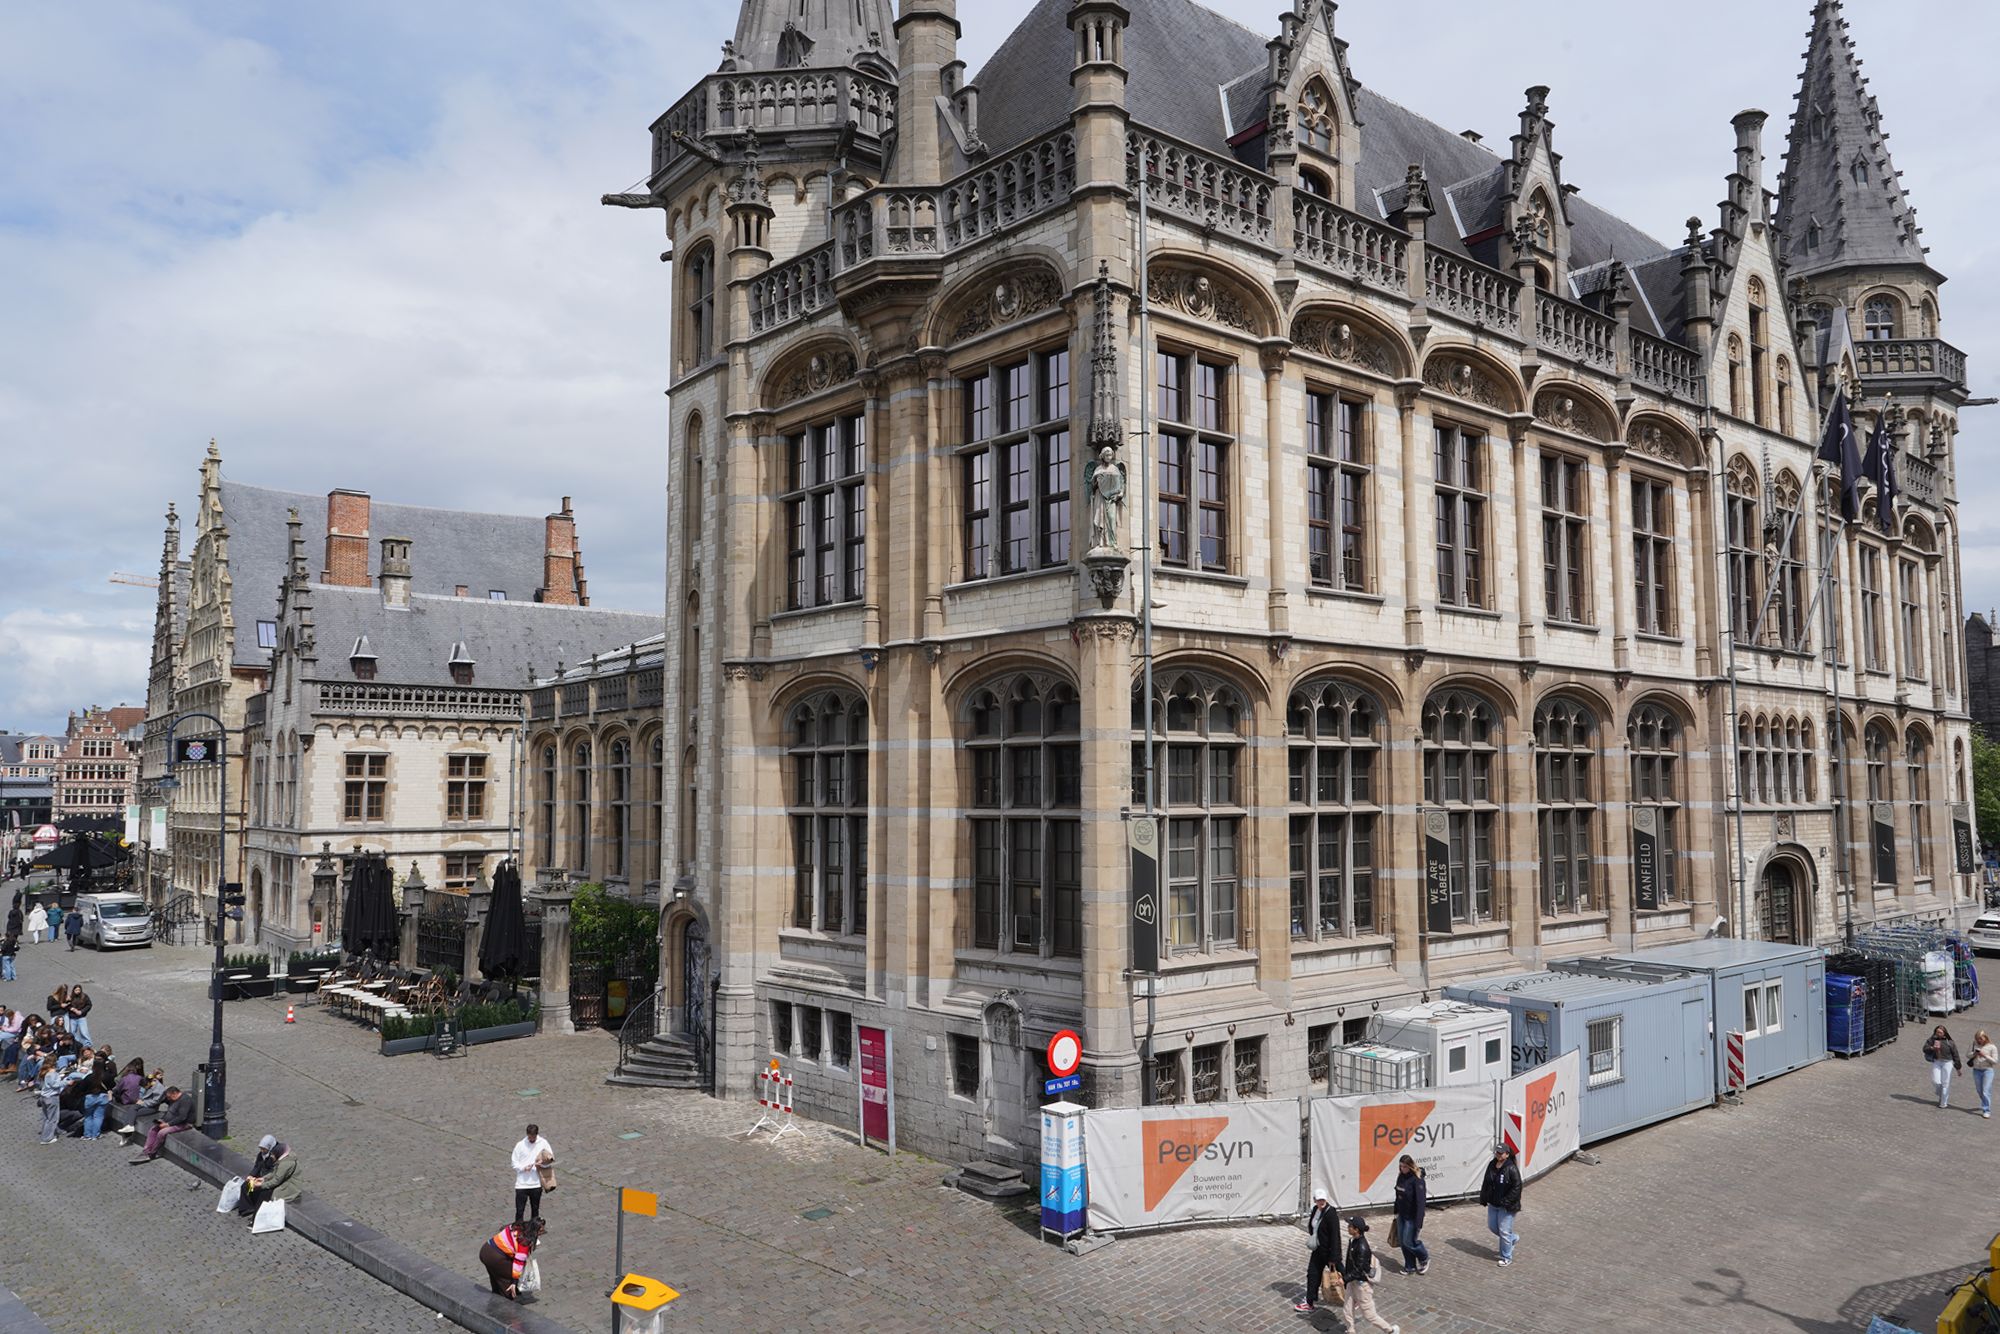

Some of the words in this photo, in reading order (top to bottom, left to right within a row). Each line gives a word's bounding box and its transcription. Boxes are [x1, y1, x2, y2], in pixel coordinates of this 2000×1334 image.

[1429, 859, 1438, 880] ARE
[1640, 843, 1652, 901] MANFIELD
[1438, 863, 1448, 901] LABELS
[1430, 888, 1438, 905] WE
[1512, 1045, 1546, 1065] SYN
[1531, 1090, 1565, 1122] Persyn
[1374, 1121, 1454, 1148] Persyn
[1158, 1139, 1254, 1167] Persyn
[1193, 1175, 1226, 1183] Bouwen
[1193, 1184, 1203, 1192] de
[1205, 1182, 1232, 1191] wereld
[1209, 1192, 1243, 1201] morgen.
